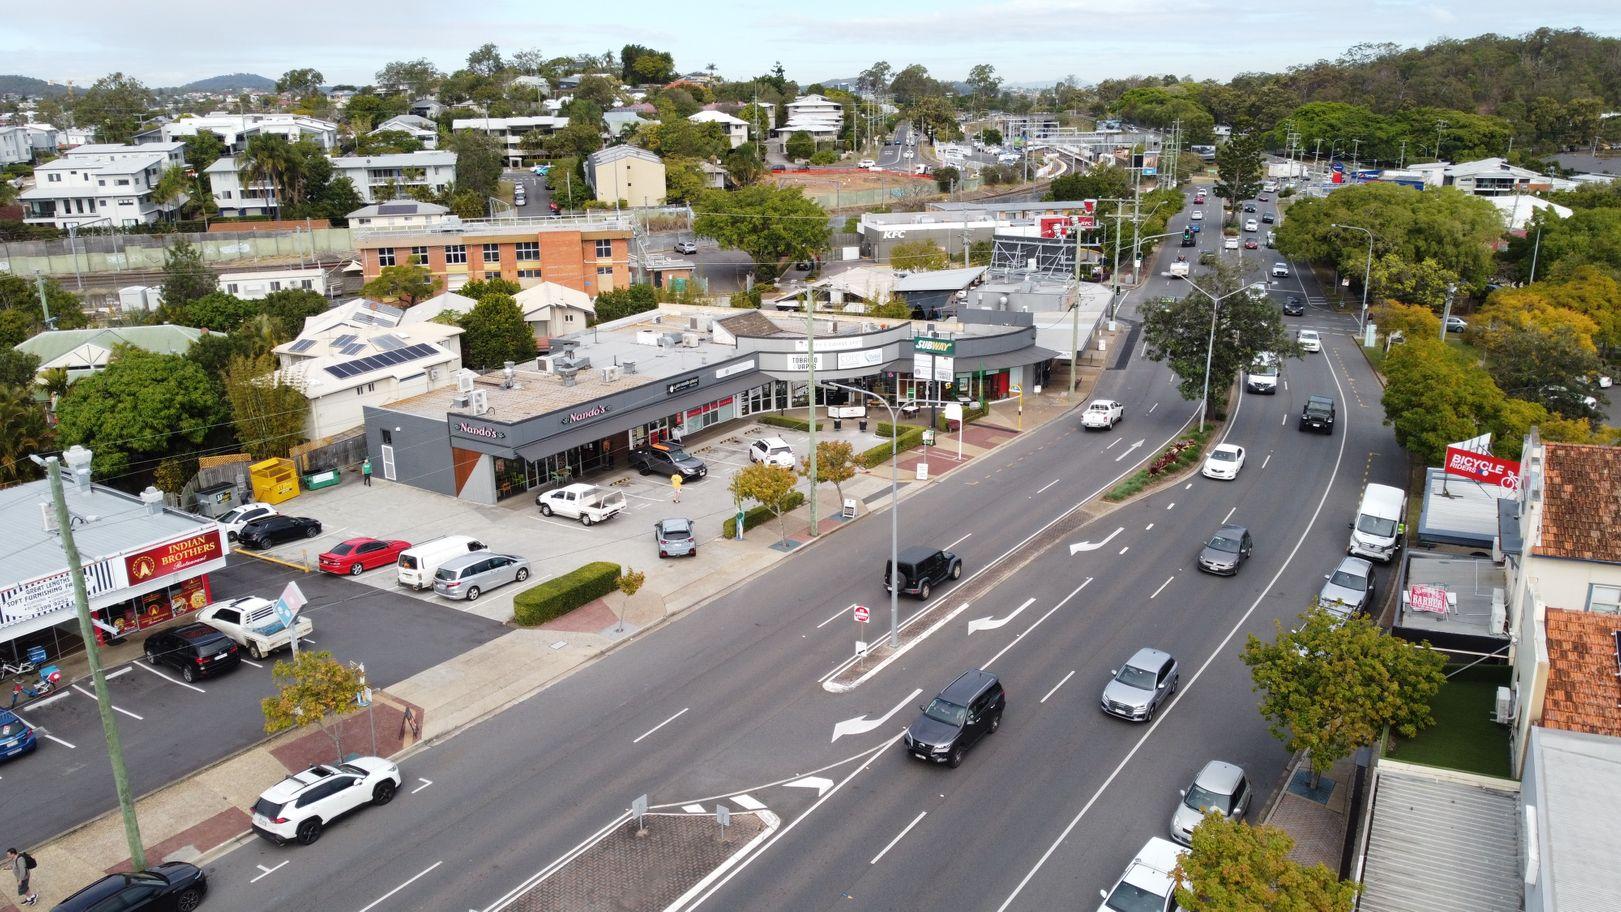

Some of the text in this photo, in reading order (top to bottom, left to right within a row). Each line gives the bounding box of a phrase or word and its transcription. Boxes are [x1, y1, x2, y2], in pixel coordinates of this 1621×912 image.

[882, 230, 906, 239] KFC
[915, 340, 951, 352] SUBWAY
[569, 404, 606, 424] Nando's
[460, 422, 497, 439] Nando's
[1449, 462, 1477, 474] RIDERS
[1452, 453, 1505, 475] BICYCLE
[161, 541, 216, 566] BROTHERS
[168, 536, 206, 555] INDIAN
[25, 584, 44, 595] GREAT
[46, 577, 70, 589] LENGTHS
[7, 598, 24, 608] SOFT
[24, 584, 63, 602] FURNISHING
[1412, 593, 1443, 609] BARBER
